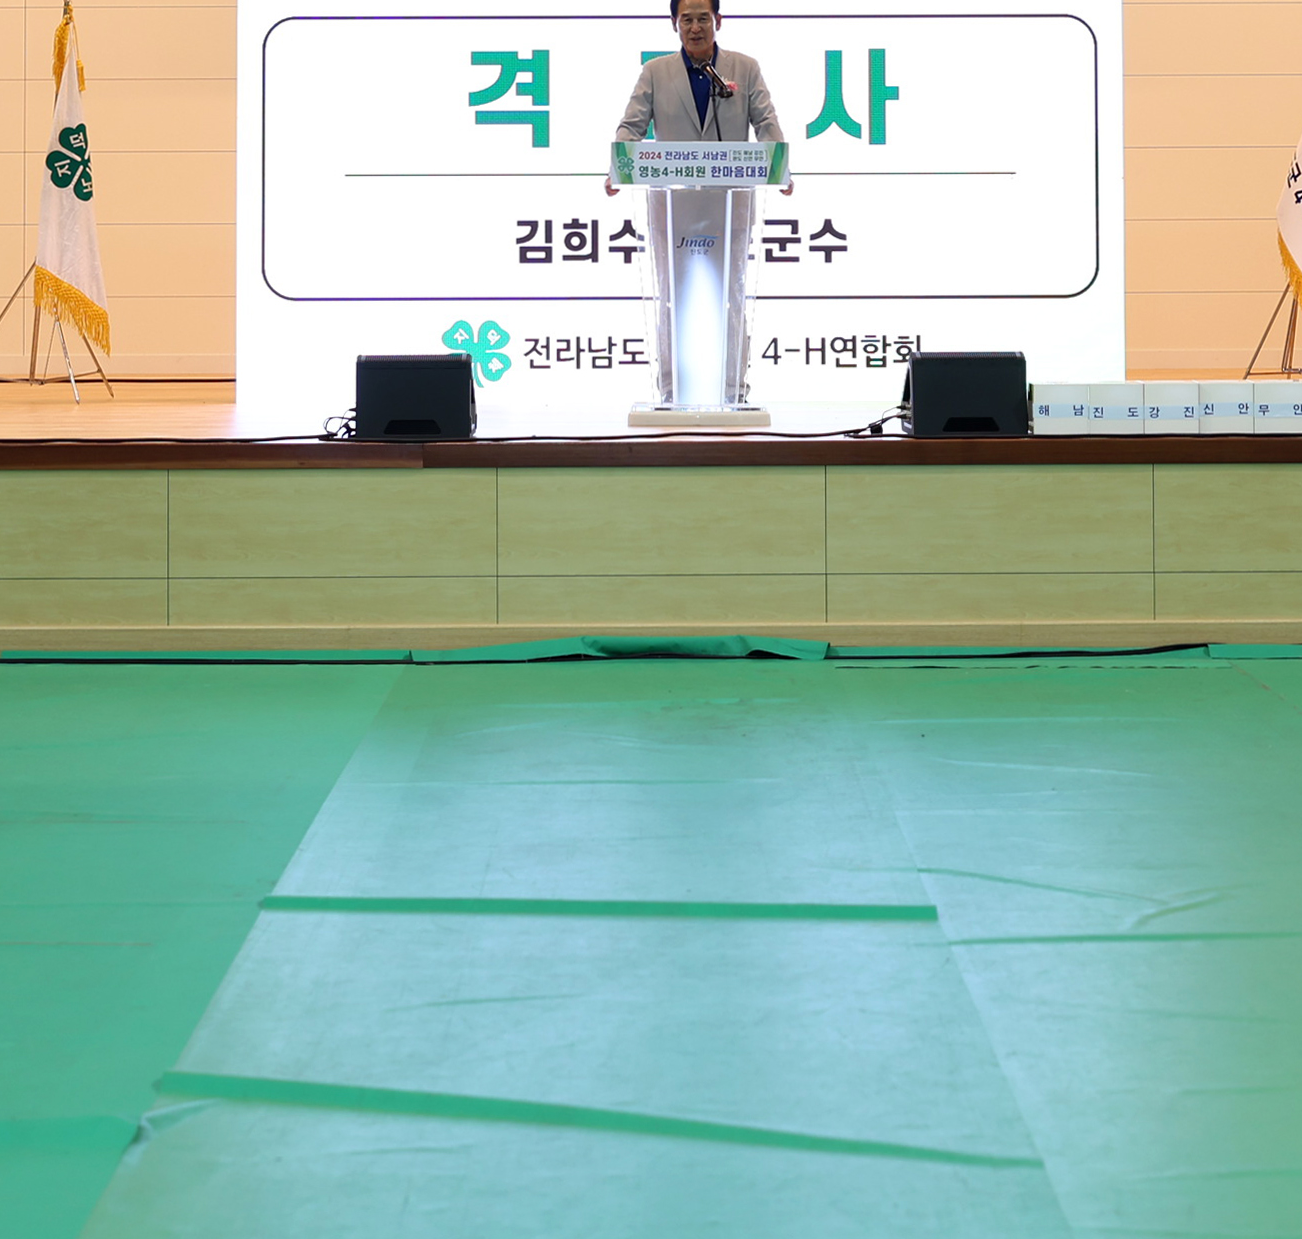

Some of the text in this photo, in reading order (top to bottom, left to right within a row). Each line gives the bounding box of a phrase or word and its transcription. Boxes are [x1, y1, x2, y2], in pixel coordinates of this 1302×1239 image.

[468, 49, 551, 149] 격
[805, 48, 900, 146] 사
[638, 151, 662, 160] 2024
[664, 150, 699, 161] 전라남도
[701, 150, 728, 161] 서남권
[638, 165, 768, 179] 영농4-H회원 한마음대회
[515, 212, 645, 264] 김희수
[523, 335, 650, 370] 전라남도
